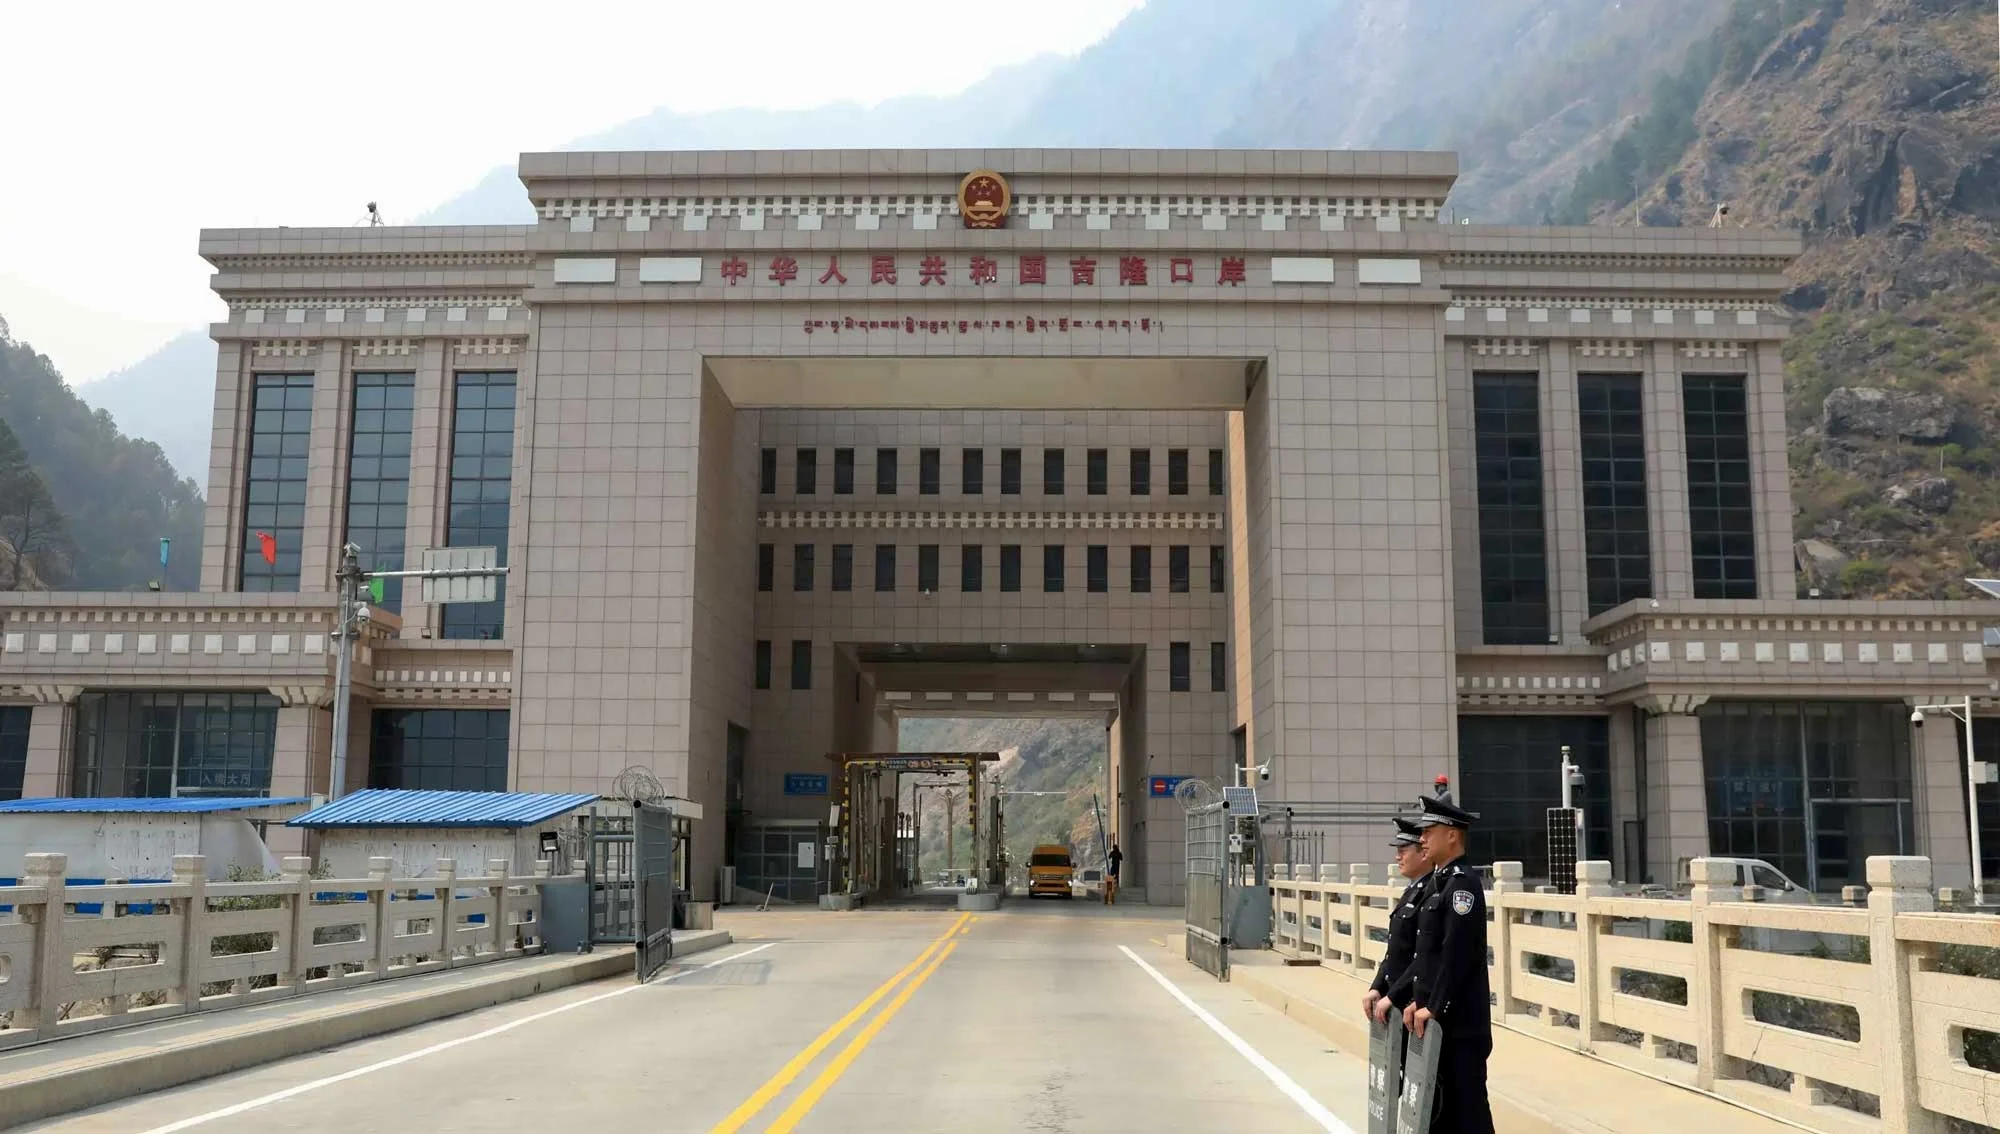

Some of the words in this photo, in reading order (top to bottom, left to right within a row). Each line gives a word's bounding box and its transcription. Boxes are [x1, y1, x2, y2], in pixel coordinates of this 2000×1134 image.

[720, 256, 1246, 286] 中华人民共和国吉隆口岸
